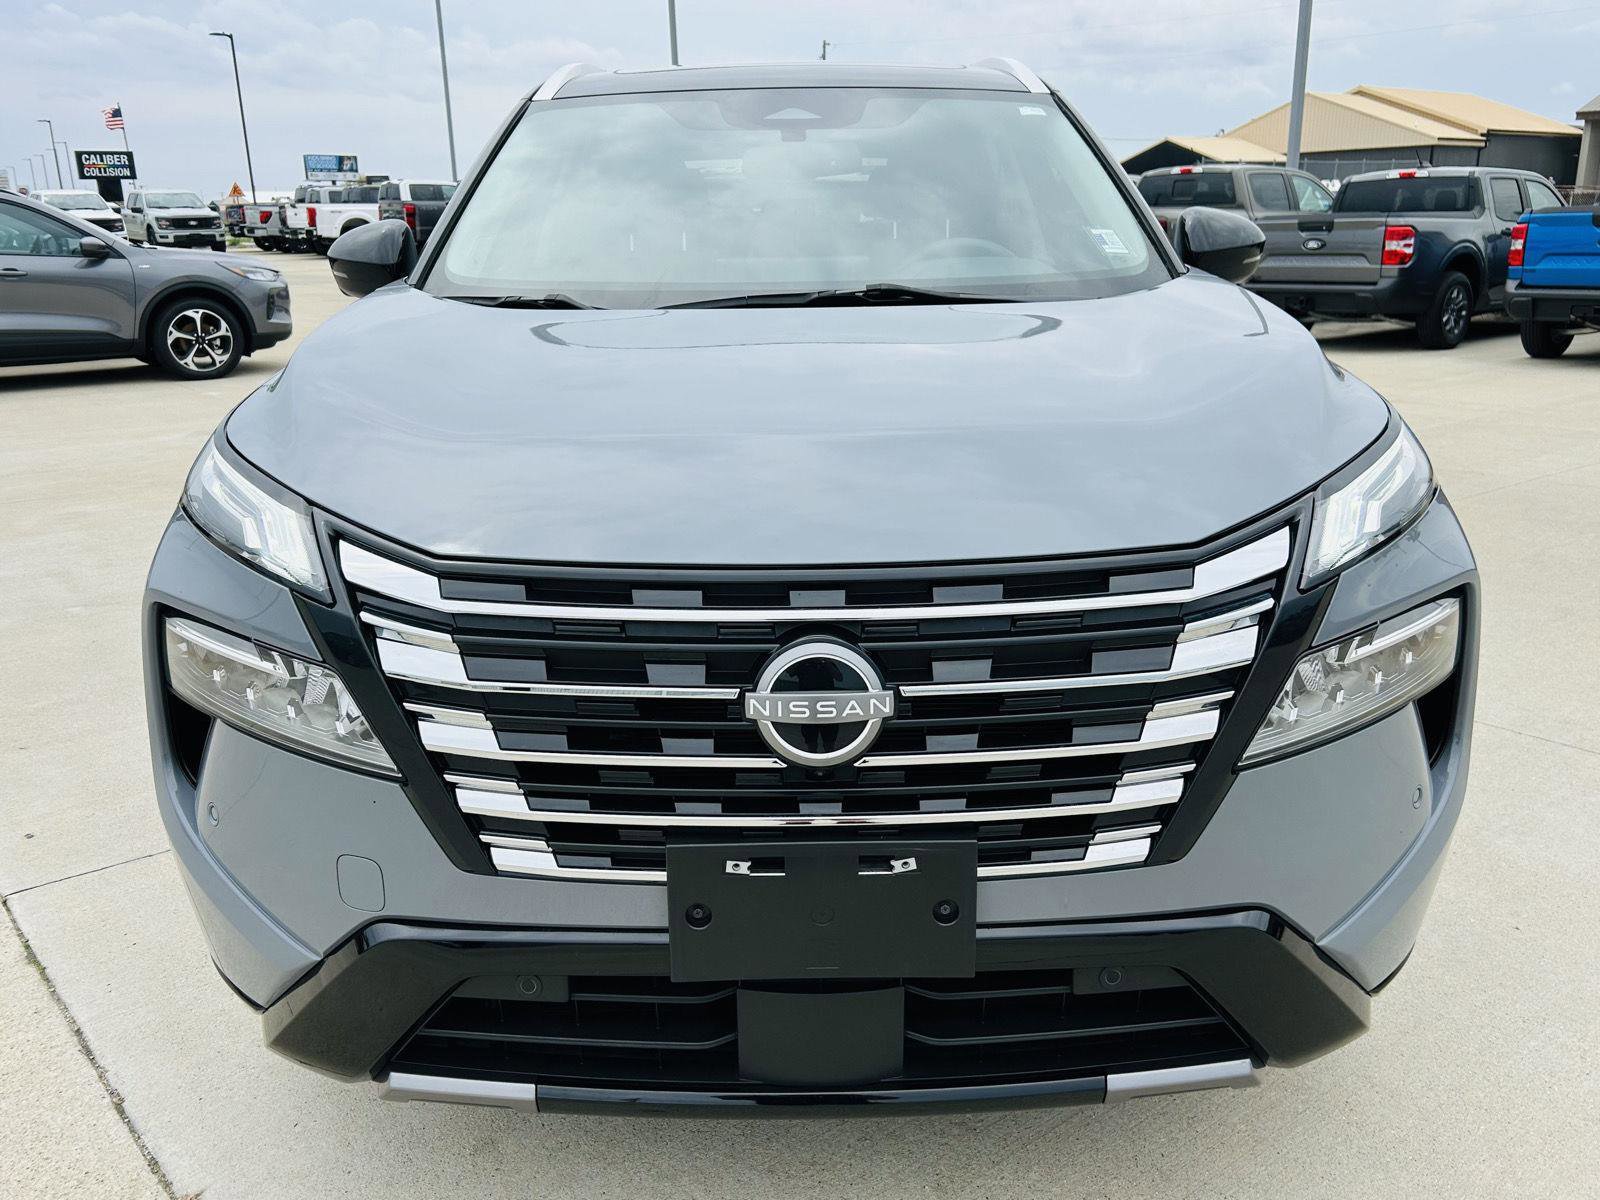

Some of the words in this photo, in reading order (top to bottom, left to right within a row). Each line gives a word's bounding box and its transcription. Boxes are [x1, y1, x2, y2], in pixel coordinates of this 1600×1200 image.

[82, 154, 129, 164] CALIBER
[84, 167, 131, 176] COLLISION
[749, 697, 890, 718] NISSAN
